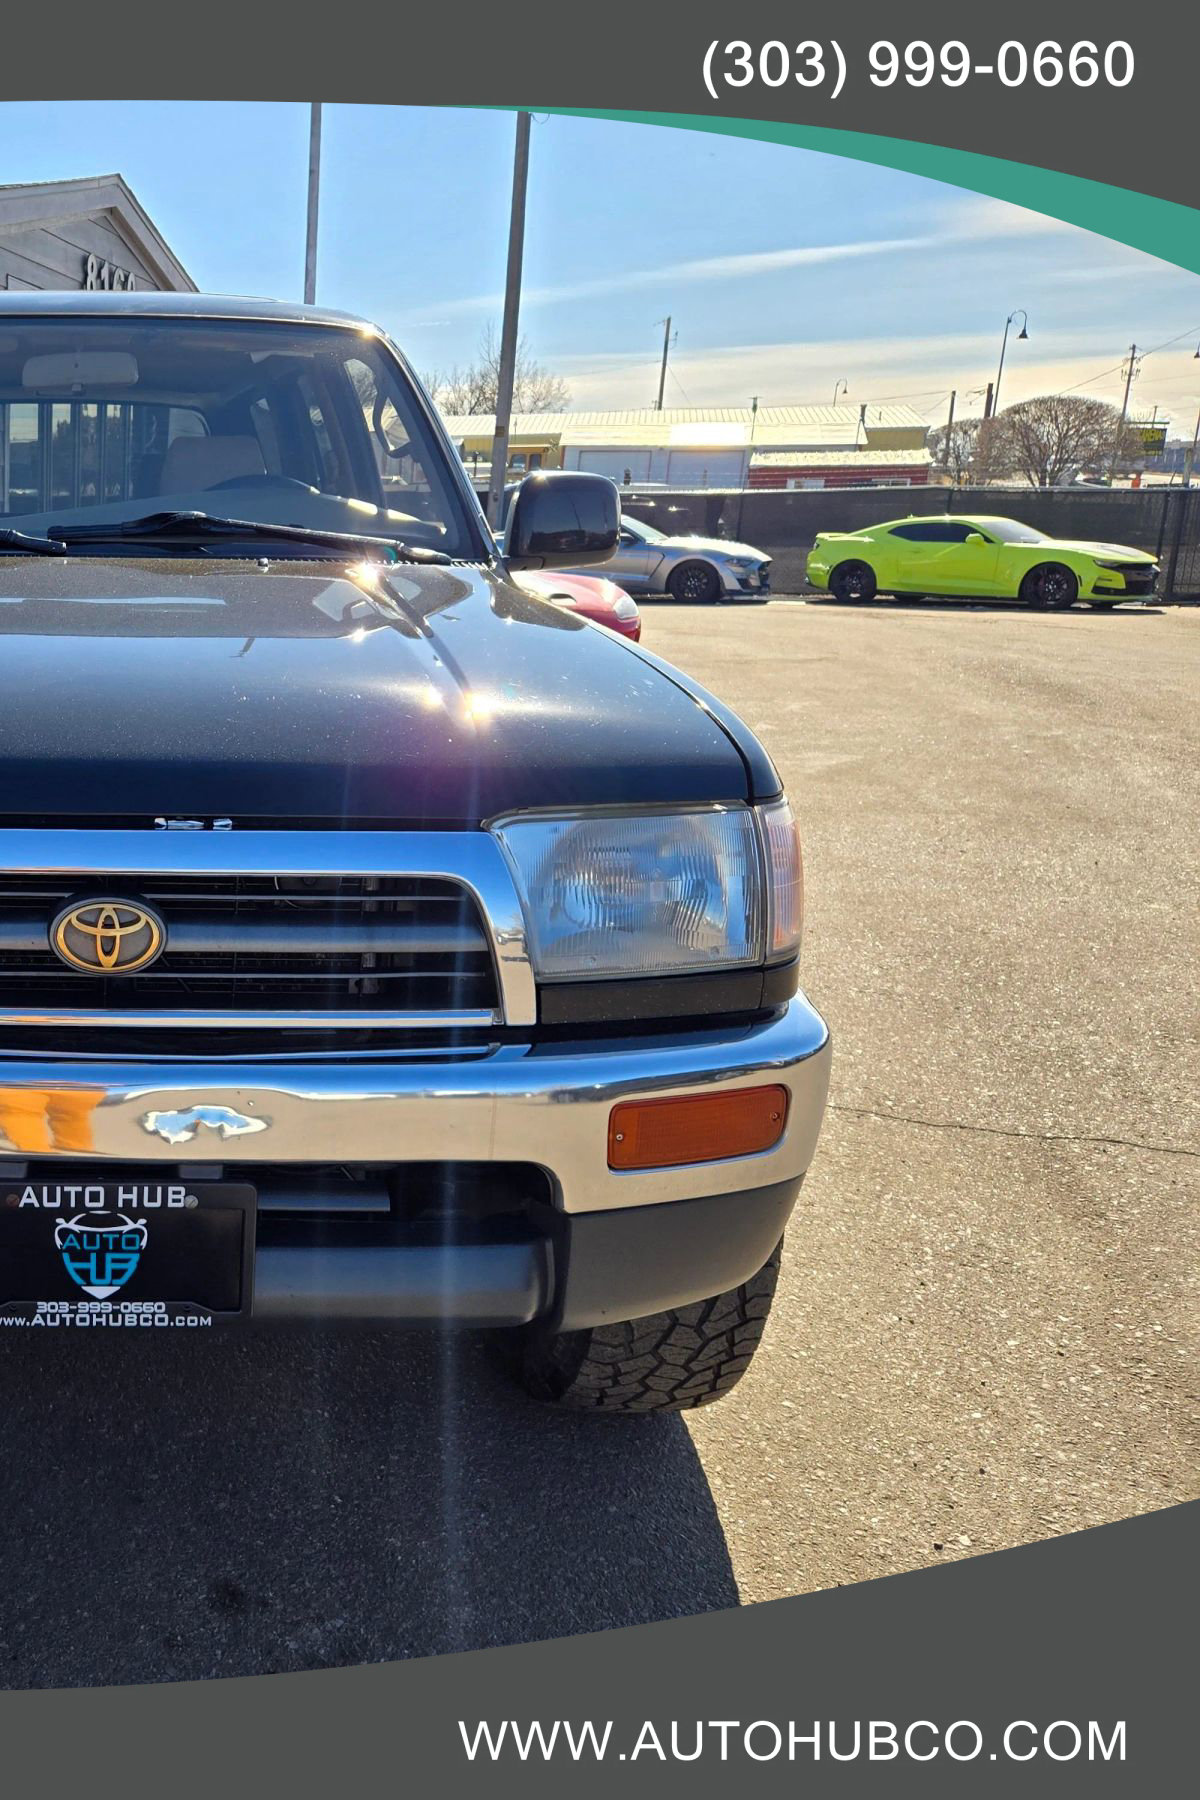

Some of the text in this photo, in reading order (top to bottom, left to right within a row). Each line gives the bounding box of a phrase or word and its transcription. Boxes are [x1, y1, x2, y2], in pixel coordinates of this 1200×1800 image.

[19, 1186, 186, 1208] AUTO HUB
[63, 1233, 140, 1250] AUTO
[62, 1252, 140, 1286] HUB
[37, 1302, 166, 1313] 303-999-0660
